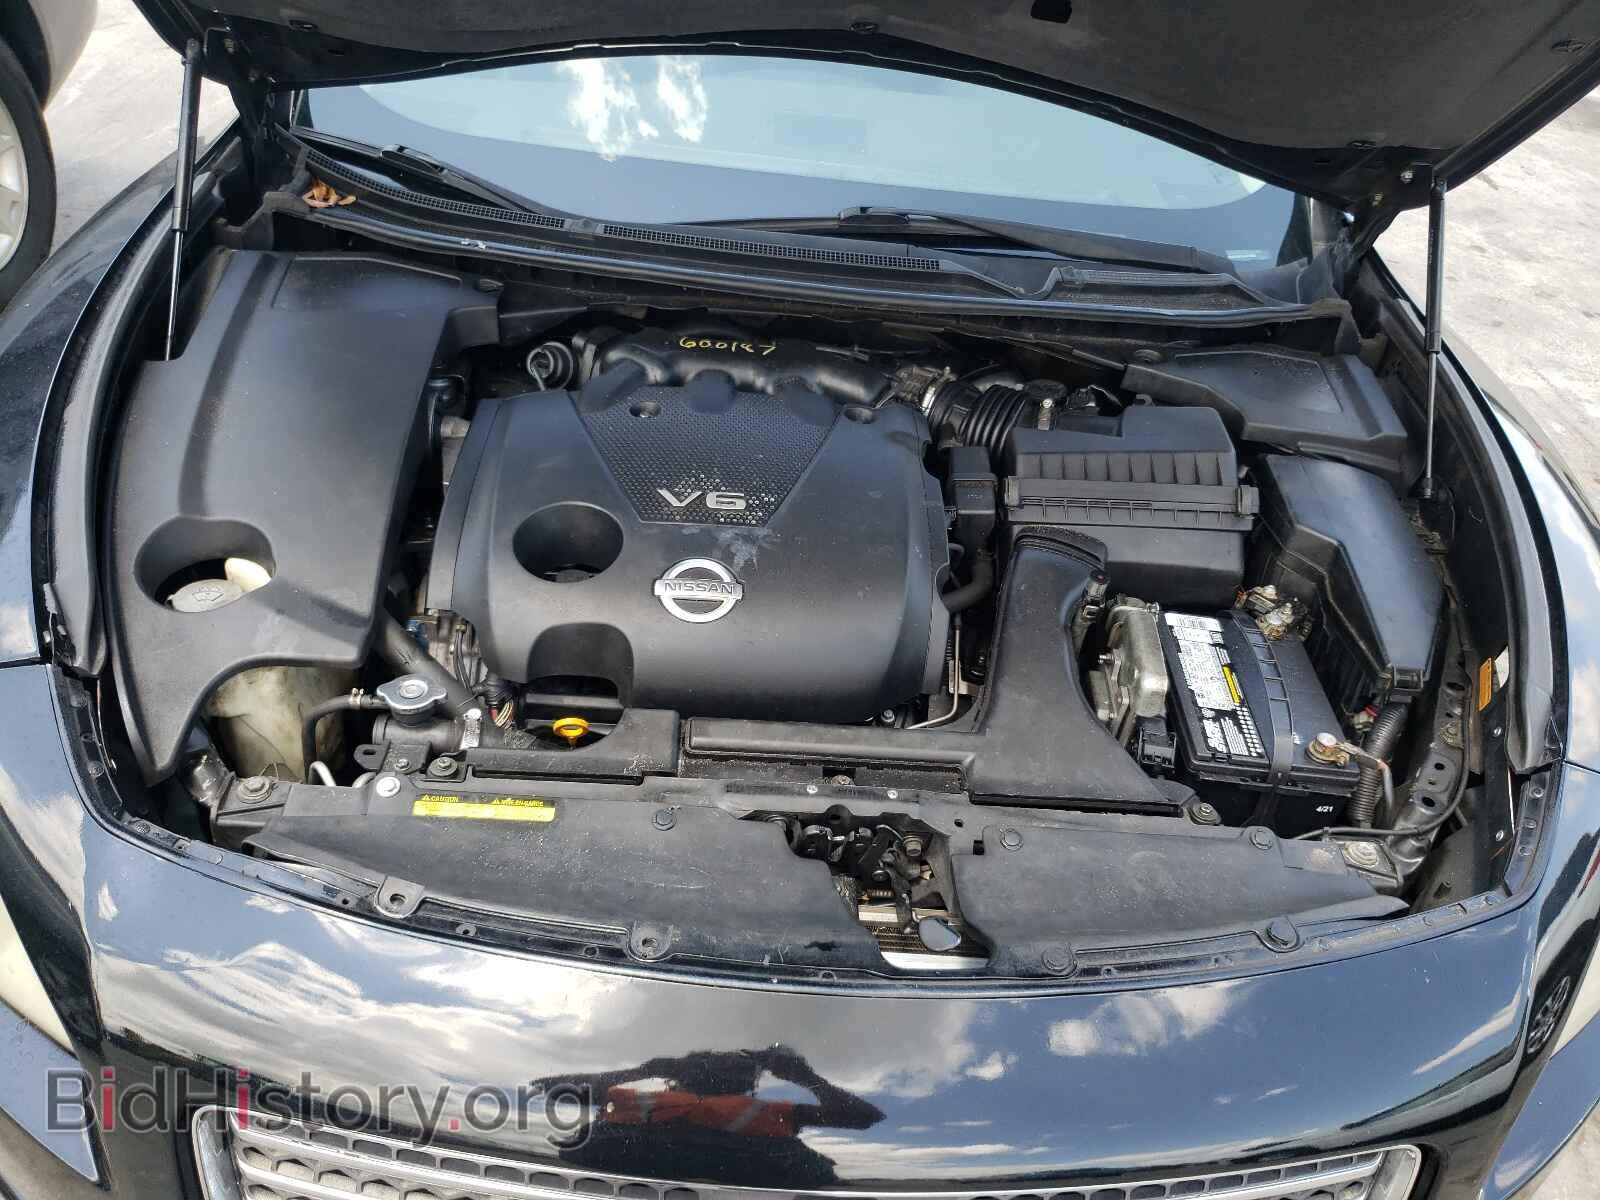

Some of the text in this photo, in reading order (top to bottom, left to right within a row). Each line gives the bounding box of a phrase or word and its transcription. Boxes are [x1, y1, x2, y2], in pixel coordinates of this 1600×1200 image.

[657, 489, 747, 510] V6
[664, 582, 734, 595] NISSAN
[1315, 805, 1334, 813] 4/21
